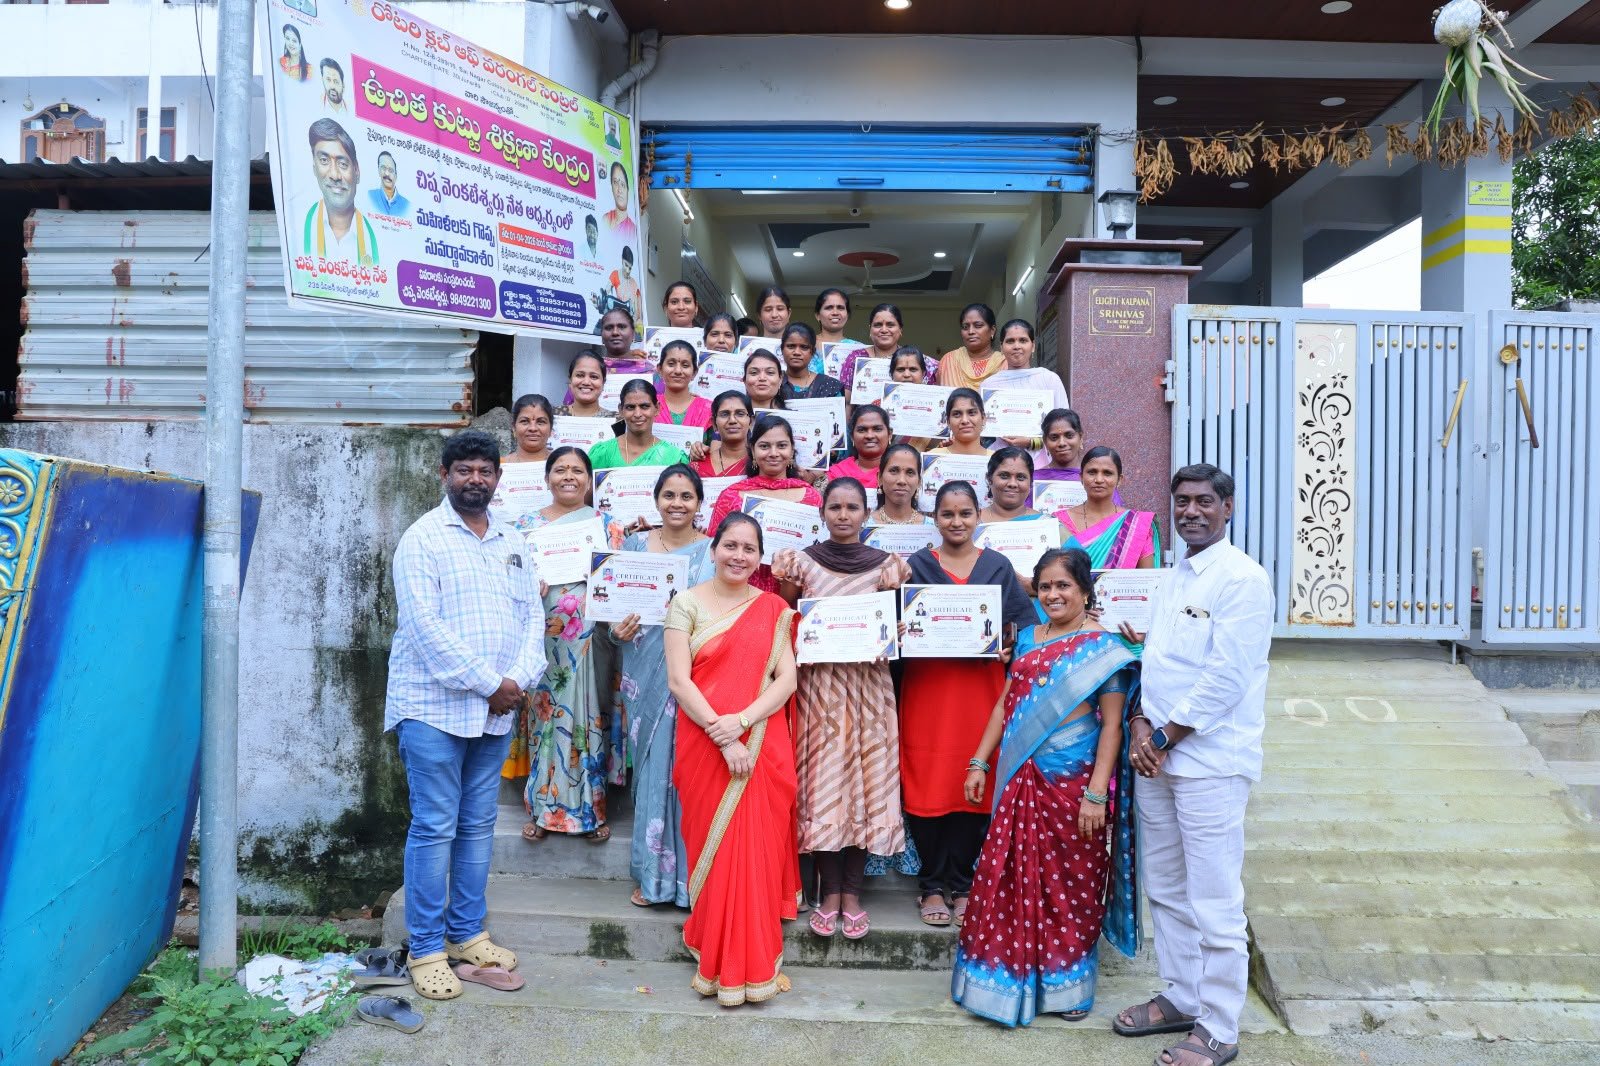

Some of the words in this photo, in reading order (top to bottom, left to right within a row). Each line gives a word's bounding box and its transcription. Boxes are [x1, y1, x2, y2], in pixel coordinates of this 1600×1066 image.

[371, 2, 421, 38] రోటరి
[425, 28, 451, 52] క్లబ్
[454, 45, 479, 68] ఆఫ్
[483, 57, 537, 92] వరంగల్
[539, 83, 579, 112] సెంట్రల్
[361, 69, 428, 123] ఉచిత
[432, 100, 482, 154] కుట్టు
[486, 124, 539, 170] శిక్షణా
[540, 138, 590, 187] కేంద్రం
[416, 170, 442, 203] చిప్ప
[441, 176, 505, 219] వెంకటేశ్వర్లు
[506, 194, 524, 217] నేత
[526, 204, 574, 234] ఆధ్వర్యంలో
[416, 208, 471, 237] మహిళలకు
[473, 222, 496, 248] గొప్ప
[425, 238, 494, 268] సువర్ణావకాశం
[295, 256, 318, 278] చిప్ప
[318, 256, 372, 286] వెంకటేశ్వర్లు
[372, 265, 388, 284] నేత
[450, 293, 491, 310] 9849221300
[1099, 310, 1145, 319] SRINIVAS
[1121, 297, 1150, 306] KALPANA
[766, 518, 806, 530] CERTIFICATE
[616, 573, 659, 581] CERTIFICATE
